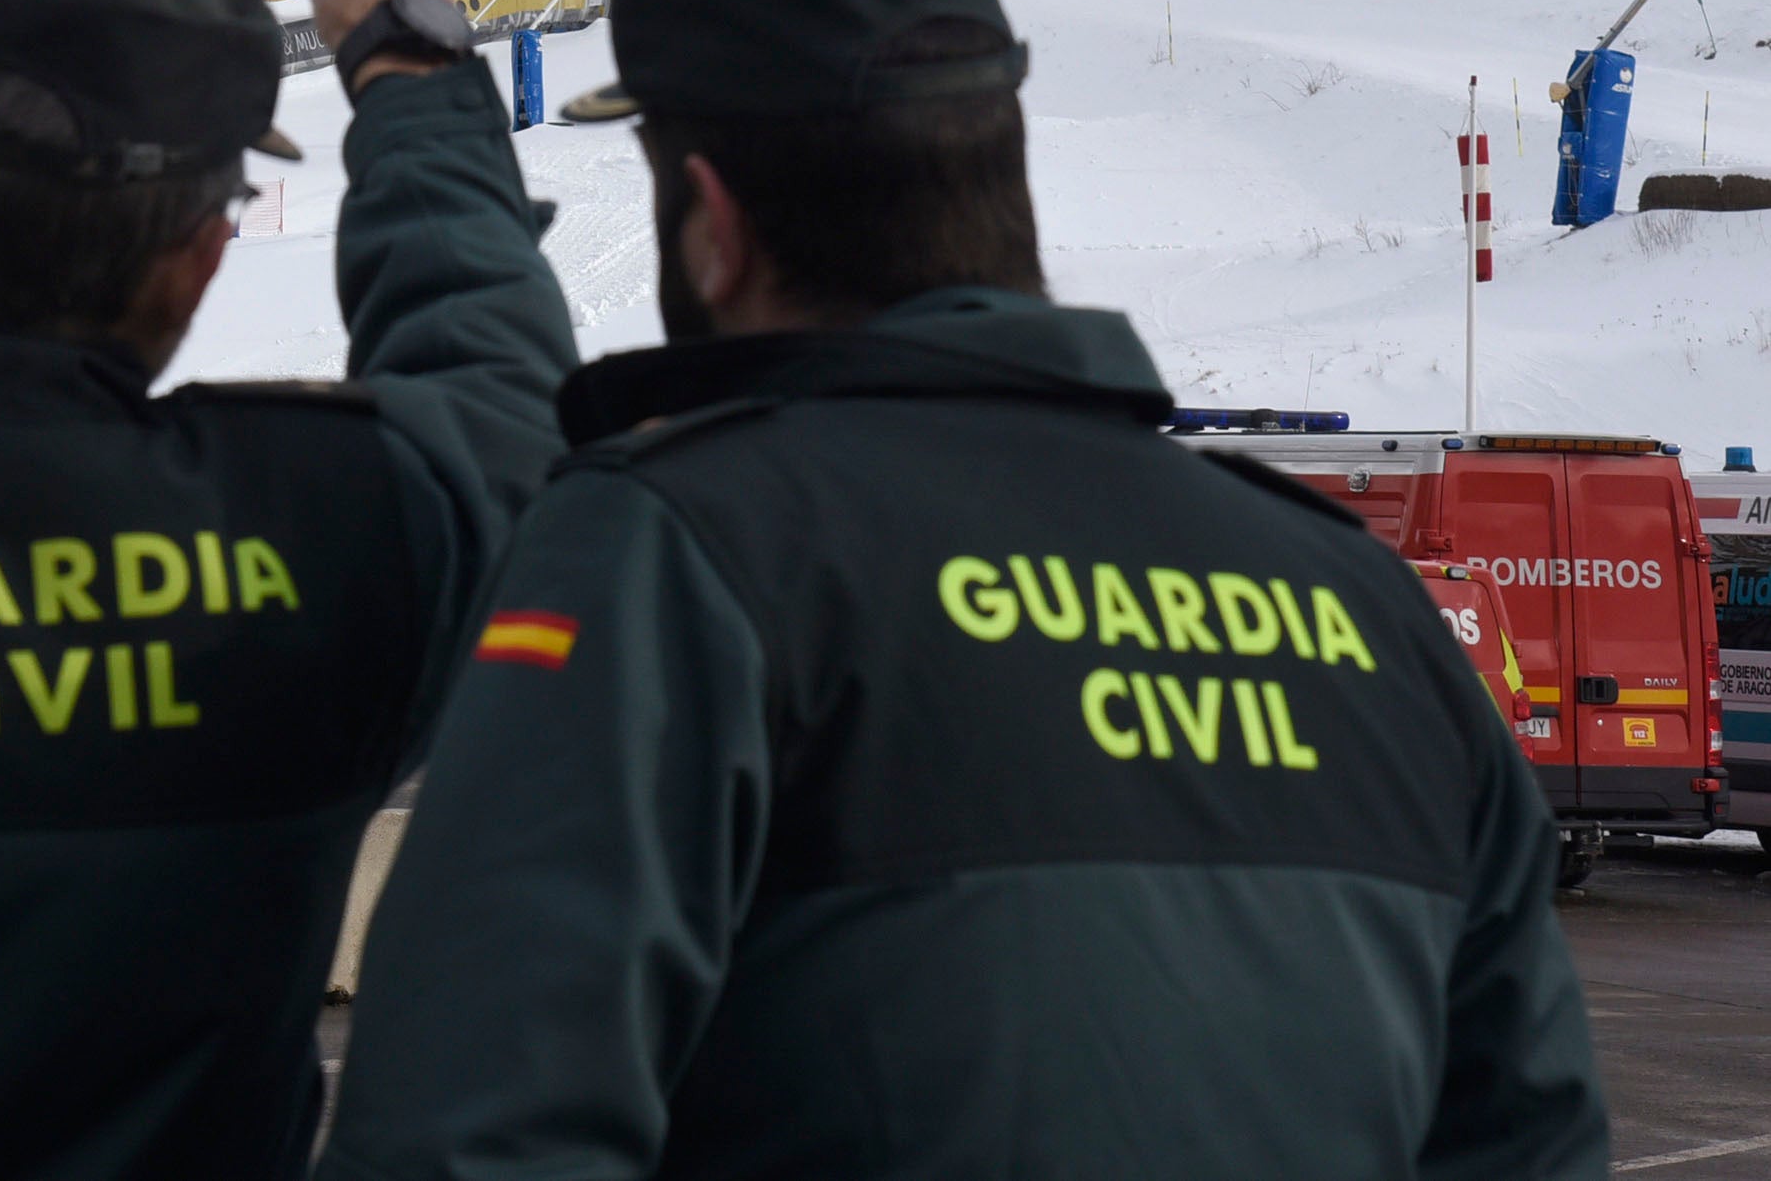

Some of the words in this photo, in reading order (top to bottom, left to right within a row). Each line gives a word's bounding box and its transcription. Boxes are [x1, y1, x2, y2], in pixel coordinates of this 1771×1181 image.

[937, 555, 1376, 672] GUARDIA
[1081, 668, 1318, 770] CIVIL
[1644, 678, 1678, 687] DAILY
